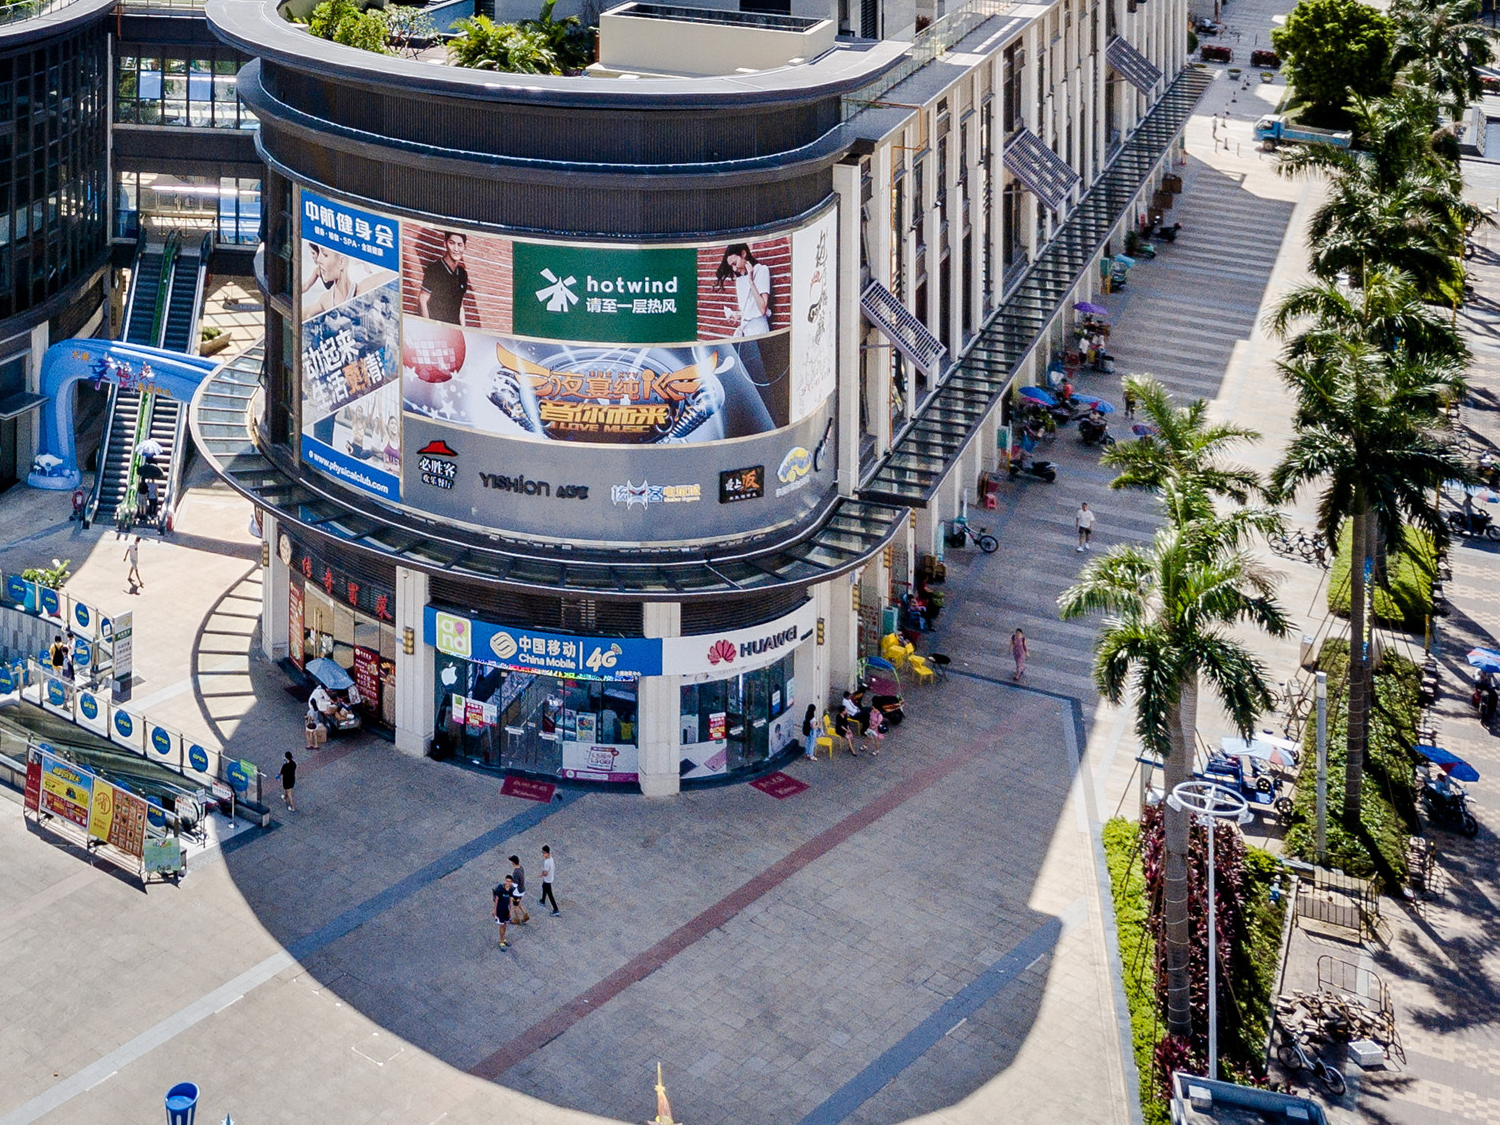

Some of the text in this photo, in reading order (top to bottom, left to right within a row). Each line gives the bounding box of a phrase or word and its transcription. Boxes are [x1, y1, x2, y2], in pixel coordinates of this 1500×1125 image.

[305, 200, 394, 248] 中航健身会
[586, 275, 678, 293] hotwind
[586, 298, 677, 313] 请至一层热风
[558, 422, 599, 432] LOVE
[603, 424, 651, 433] MUSIC
[314, 453, 389, 494] www.physicalclub.com
[419, 457, 457, 477] 必胜客
[518, 635, 576, 658] 中国移动
[739, 625, 798, 658] HUAWEI
[519, 652, 545, 665] China
[546, 656, 576, 670] Mobile
[586, 647, 618, 672] 4G
